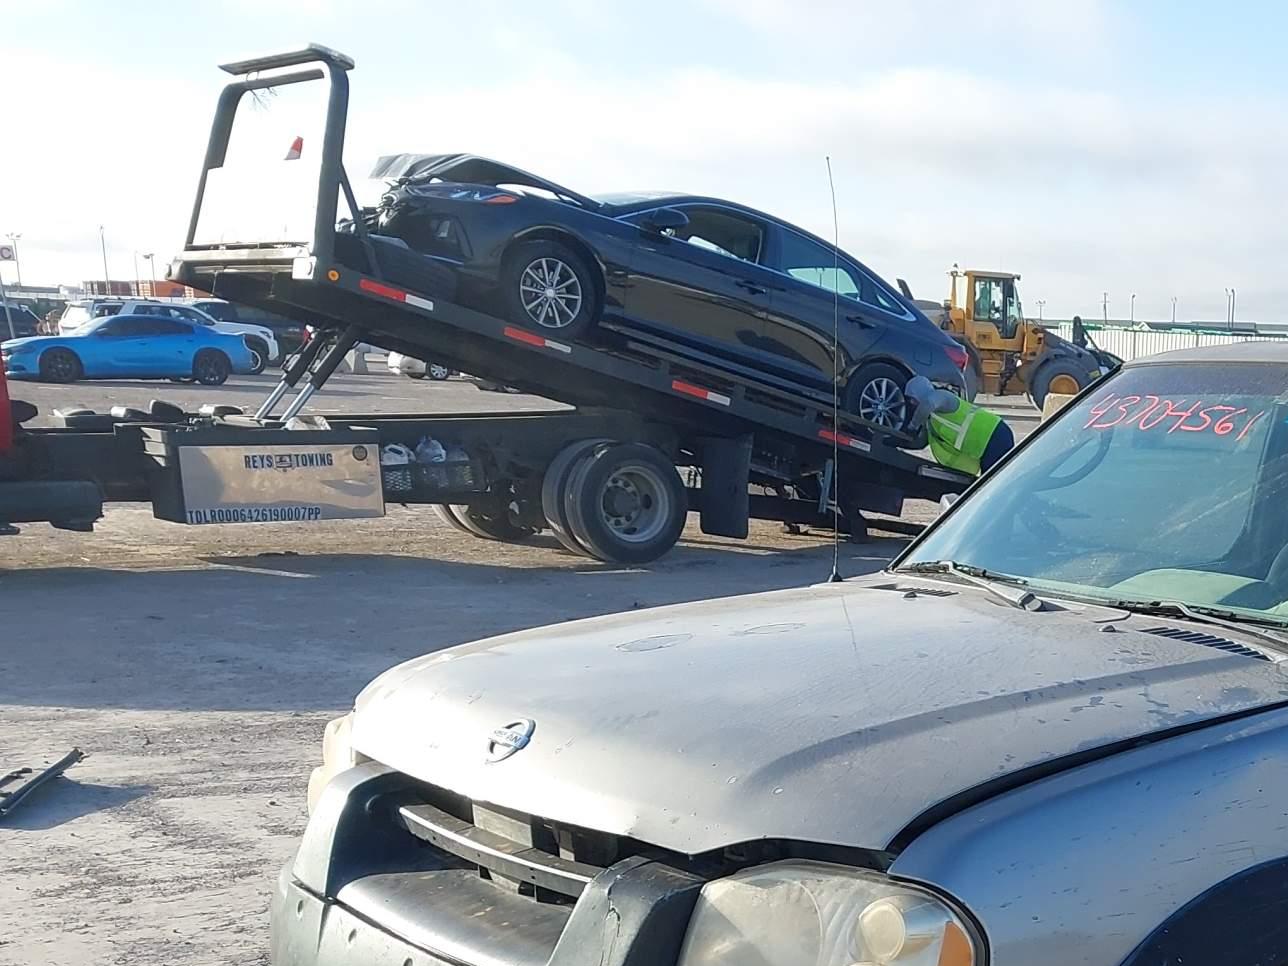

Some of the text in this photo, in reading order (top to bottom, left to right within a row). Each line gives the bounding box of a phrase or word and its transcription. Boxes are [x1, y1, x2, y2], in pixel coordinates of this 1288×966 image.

[1083, 393, 1265, 442] 43704561
[244, 452, 333, 469] REYS TOWING
